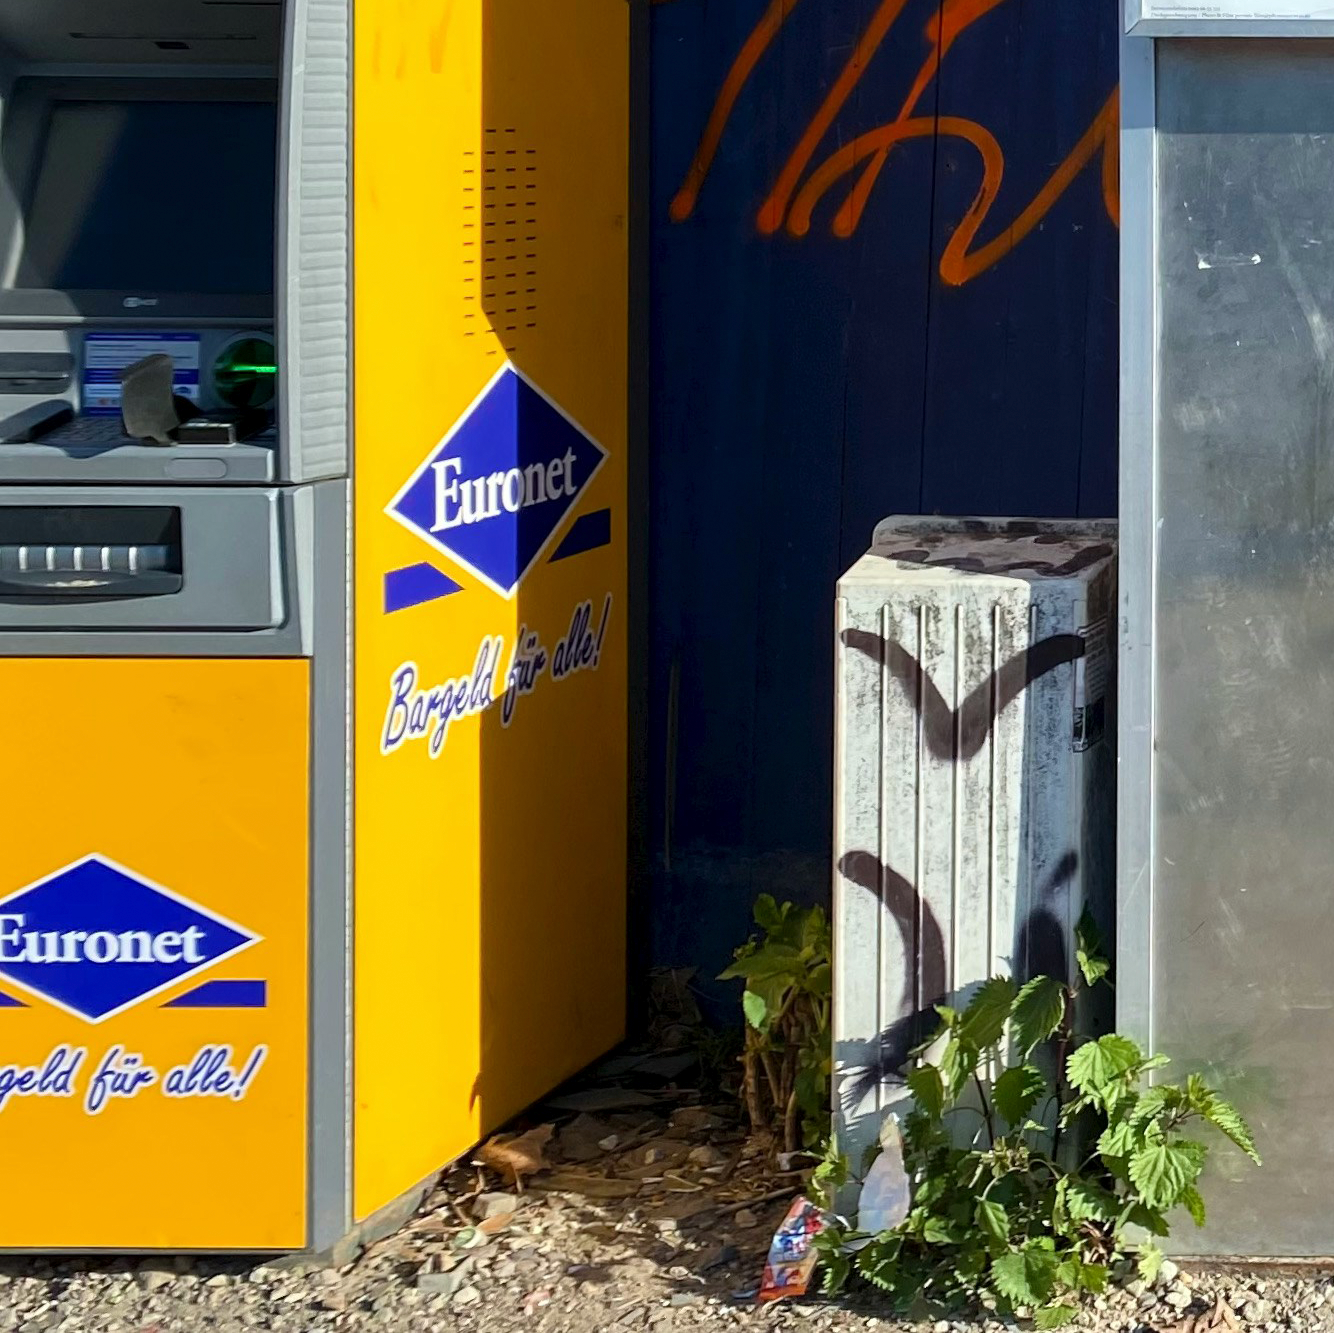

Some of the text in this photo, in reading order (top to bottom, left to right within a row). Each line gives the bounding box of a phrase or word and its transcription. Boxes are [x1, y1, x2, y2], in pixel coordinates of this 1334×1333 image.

[430, 446, 578, 533] Euronet
[380, 592, 612, 759] Bargeld für alle!
[0, 913, 207, 963] Euronet
[84, 1044, 156, 1115] für
[162, 1043, 268, 1100] alle!
